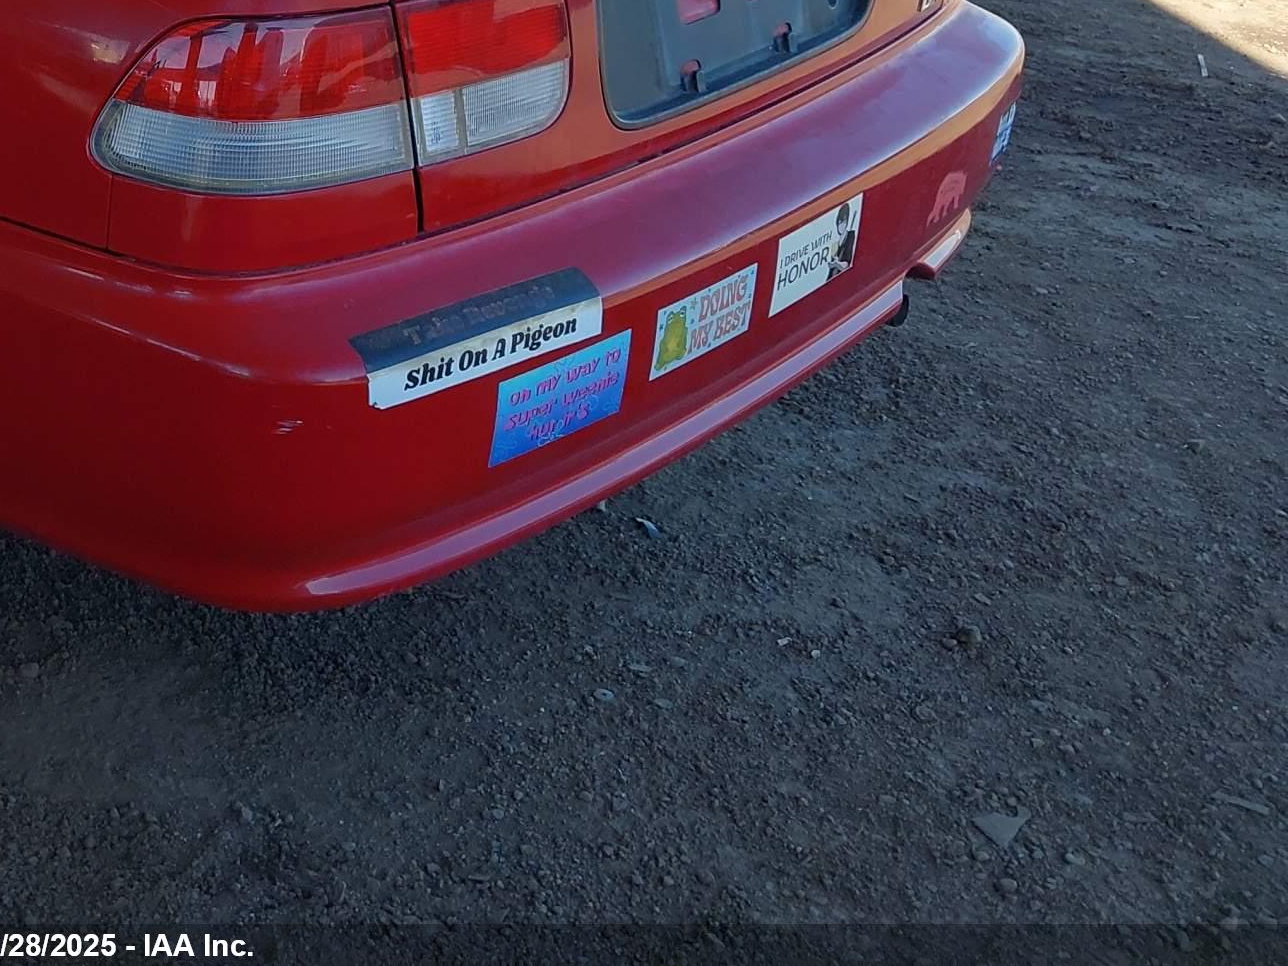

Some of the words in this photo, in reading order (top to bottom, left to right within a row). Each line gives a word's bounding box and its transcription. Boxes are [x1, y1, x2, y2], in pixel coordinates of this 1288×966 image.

[776, 246, 830, 291] HONOR
[784, 244, 810, 267] DRIVE
[811, 230, 833, 251] WITH
[698, 274, 750, 323] DOING
[687, 320, 714, 355] MY
[712, 300, 752, 341] BEST
[404, 357, 454, 392] Shit
[458, 347, 488, 372] On
[491, 338, 506, 362] A
[509, 317, 578, 355] Pigeon
